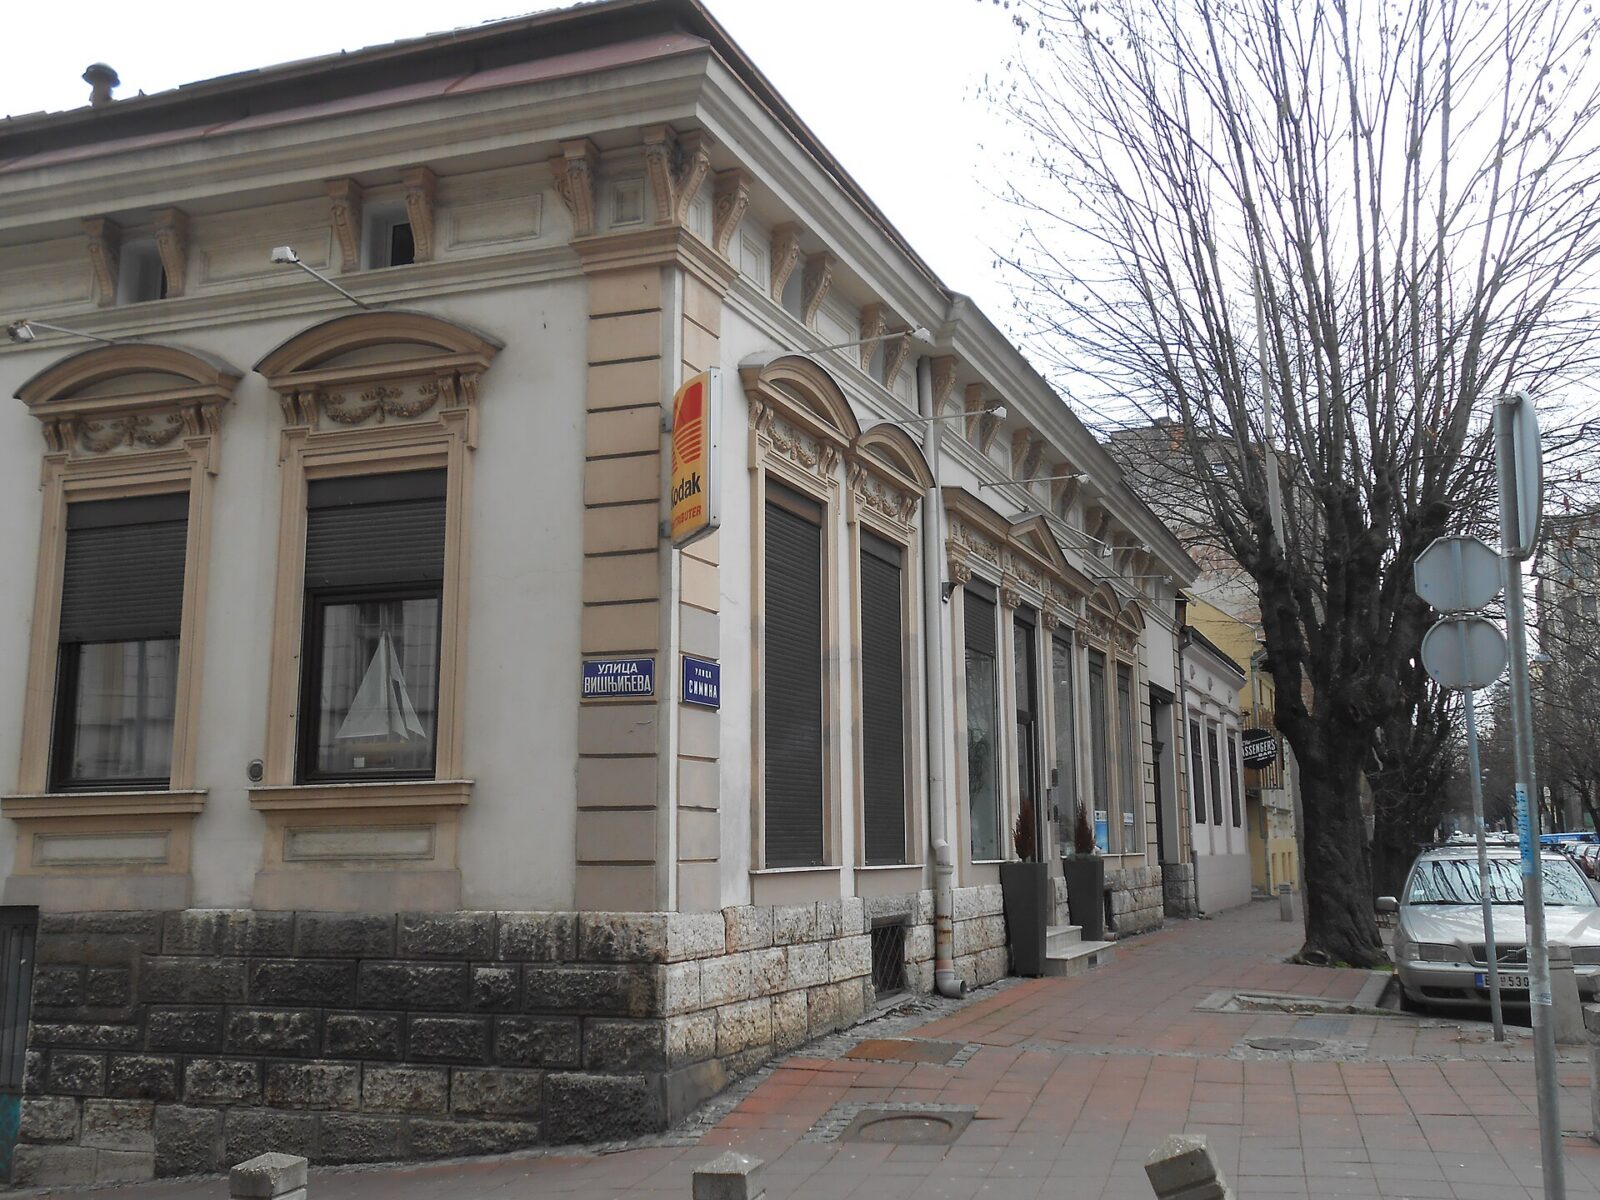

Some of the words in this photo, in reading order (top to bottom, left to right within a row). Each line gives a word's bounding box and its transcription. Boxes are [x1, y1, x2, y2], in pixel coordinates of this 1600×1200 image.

[598, 663, 638, 674] УЛИЦА
[584, 675, 651, 693] ВИШЊИЋЕВА
[689, 680, 717, 698] СИМИНА
